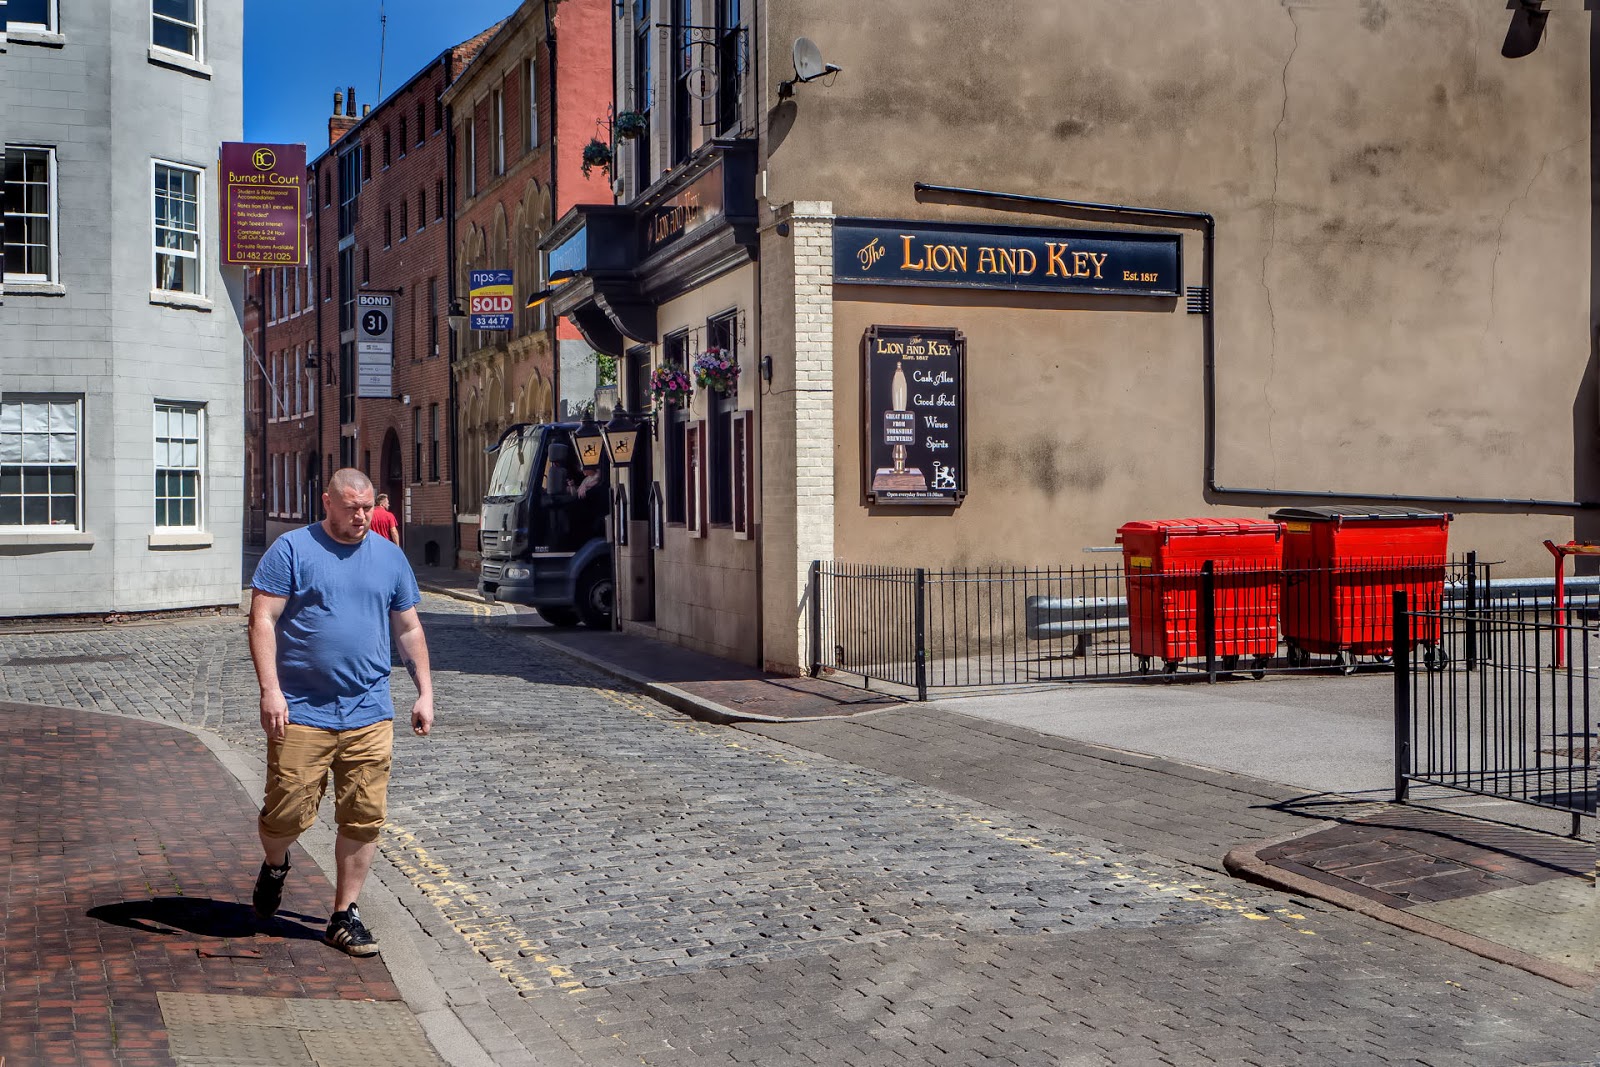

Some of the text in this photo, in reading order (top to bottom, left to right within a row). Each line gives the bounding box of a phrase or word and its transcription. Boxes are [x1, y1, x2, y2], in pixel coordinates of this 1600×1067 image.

[229, 171, 299, 184] Burnett Court
[236, 251, 291, 261] 01482 221025
[857, 237, 886, 271] The
[900, 234, 1108, 279] LION AND KEY
[473, 273, 494, 286] nps
[1122, 270, 1159, 282] Est. 1817
[360, 296, 390, 306] BOND
[472, 297, 512, 312] SOLD
[367, 315, 382, 331] 31
[476, 317, 510, 325] 33 44 77
[877, 338, 953, 356] LION AND KEY
[913, 370, 954, 386] Cask Ales
[913, 393, 956, 407] Good Food
[923, 415, 949, 429] Wines
[925, 436, 949, 452] Spirits
